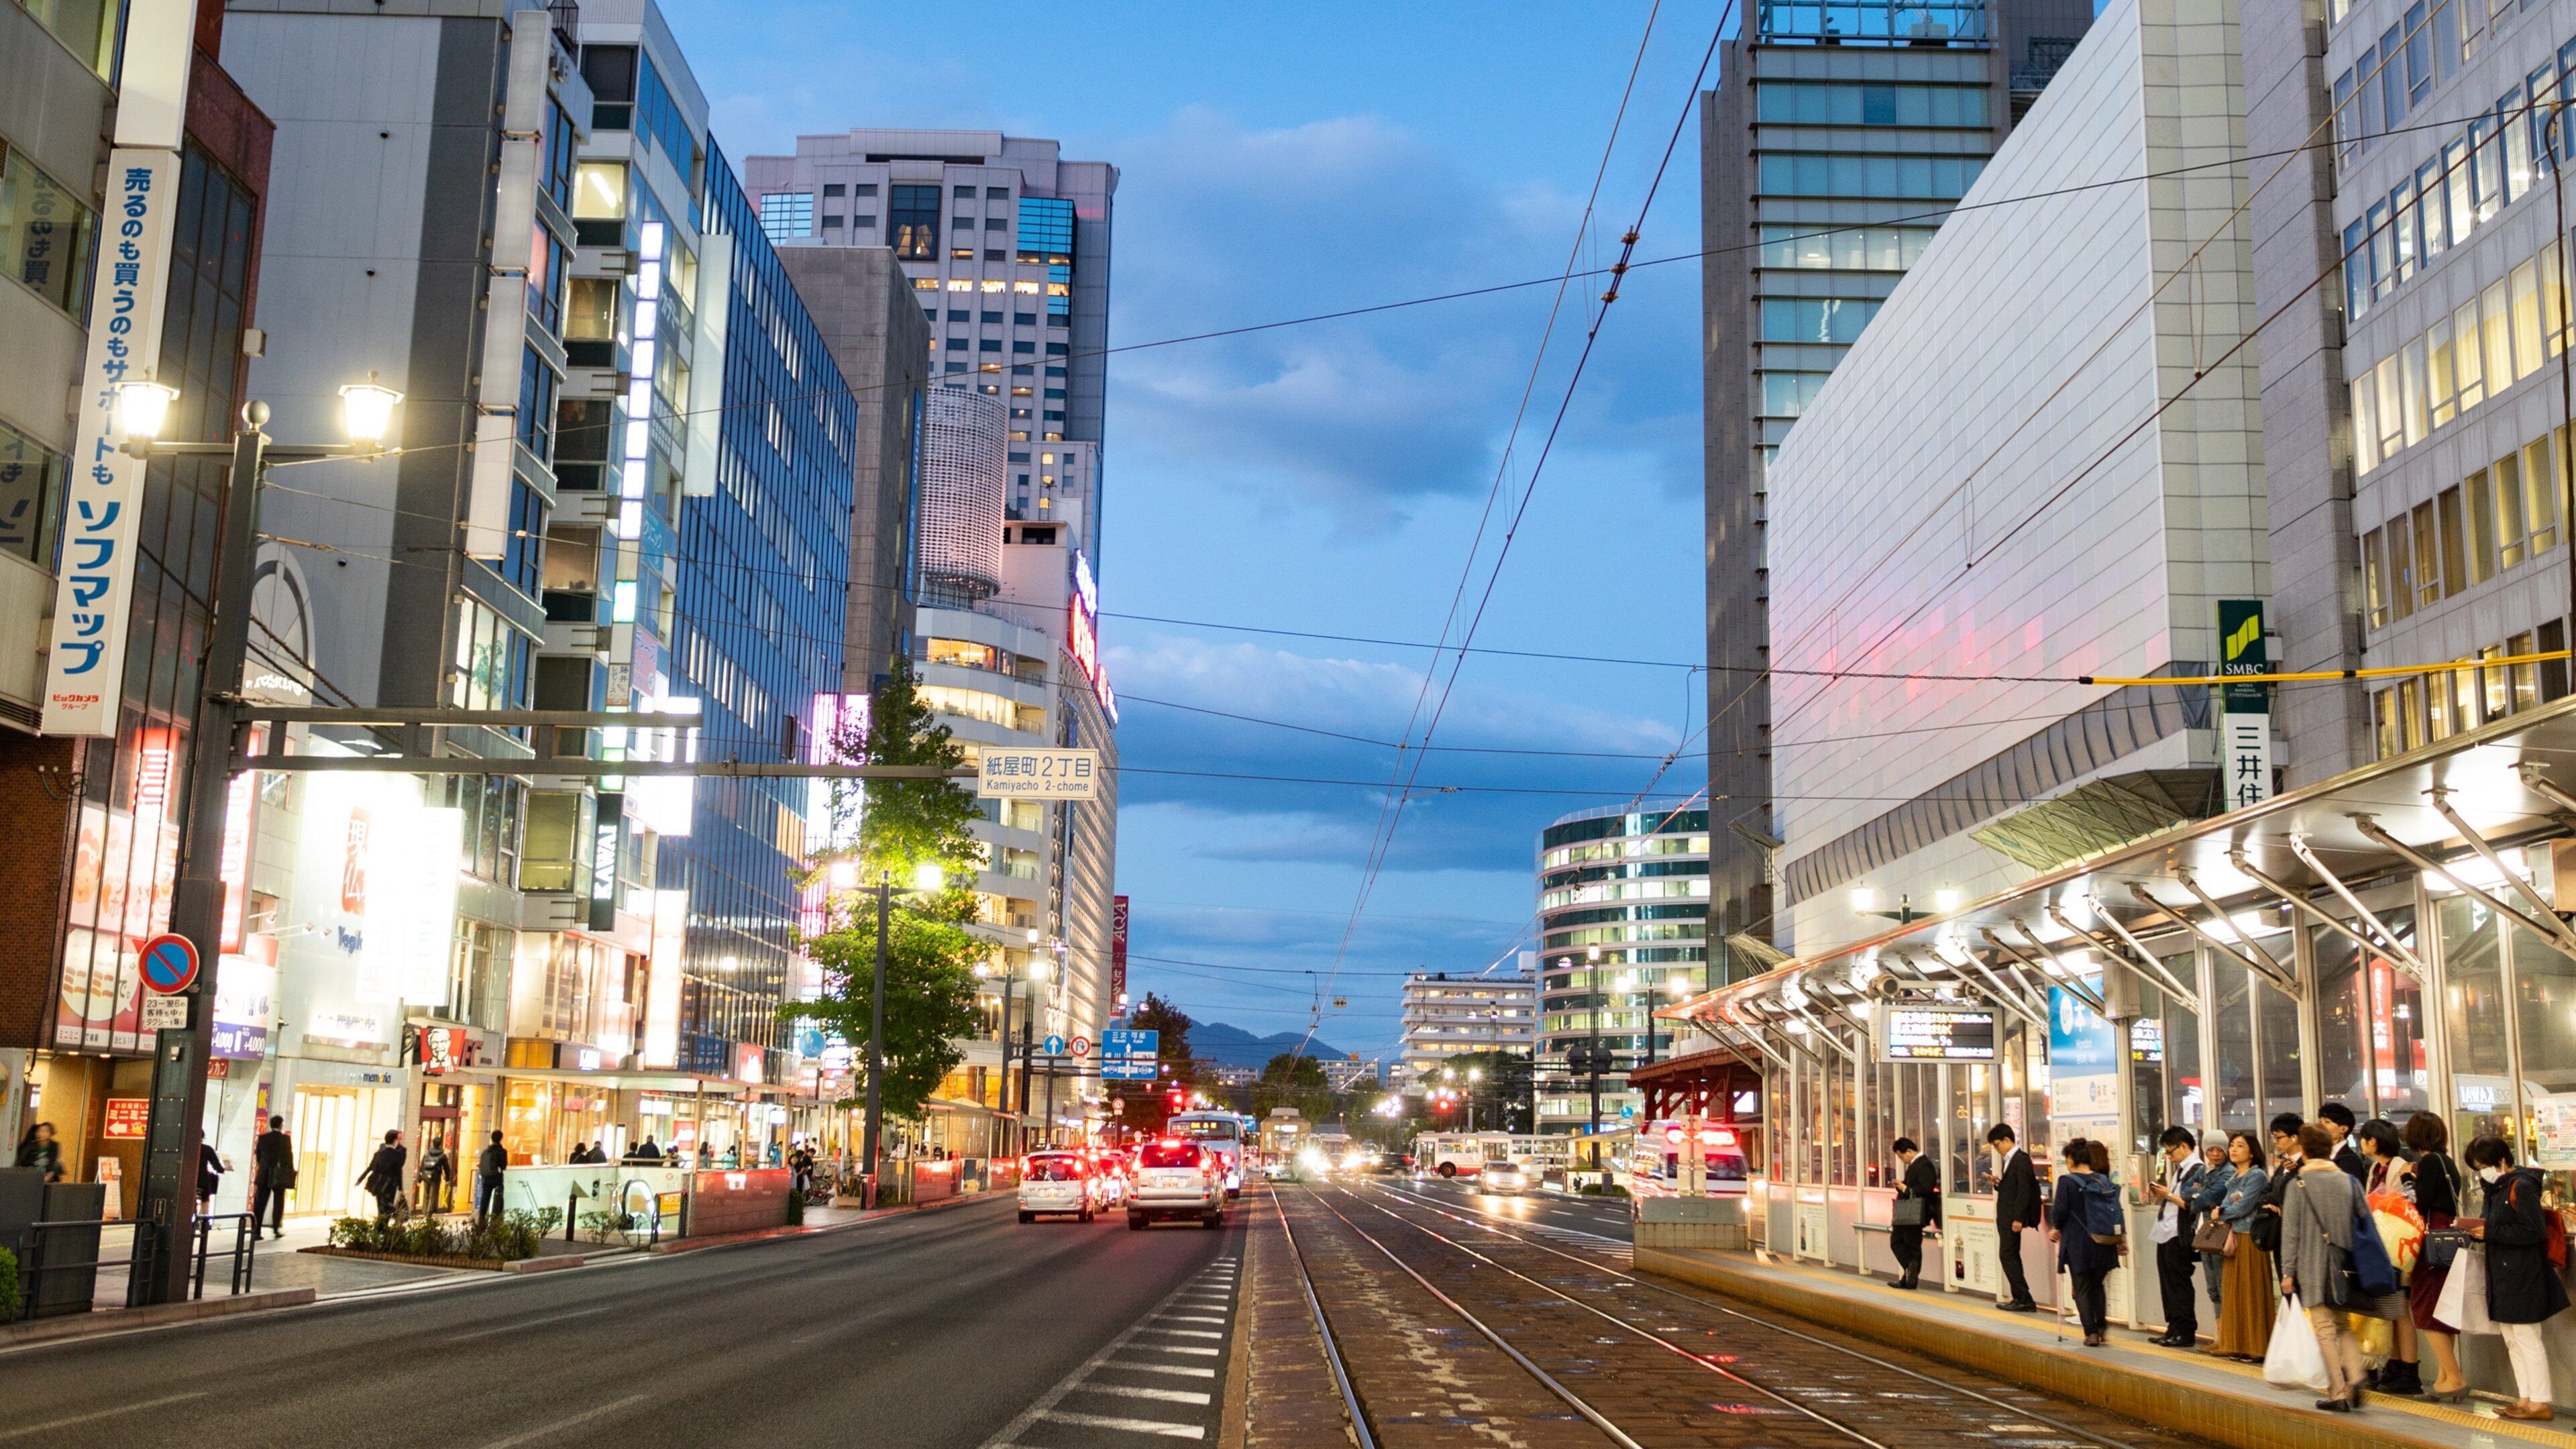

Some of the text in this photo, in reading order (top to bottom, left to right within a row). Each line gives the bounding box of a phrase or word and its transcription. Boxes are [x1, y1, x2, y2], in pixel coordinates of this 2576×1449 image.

[60, 501, 121, 674] ソフマップ
[2226, 663, 2263, 675] SMBC
[53, 694, 99, 702] ビックカメラ
[986, 756, 1091, 777] 紙屋町2丁目
[987, 780, 1089, 792] Kamiyacho 2-chome
[594, 824, 617, 900] KAWAI
[146, 1008, 184, 1017] 客待ち中の
